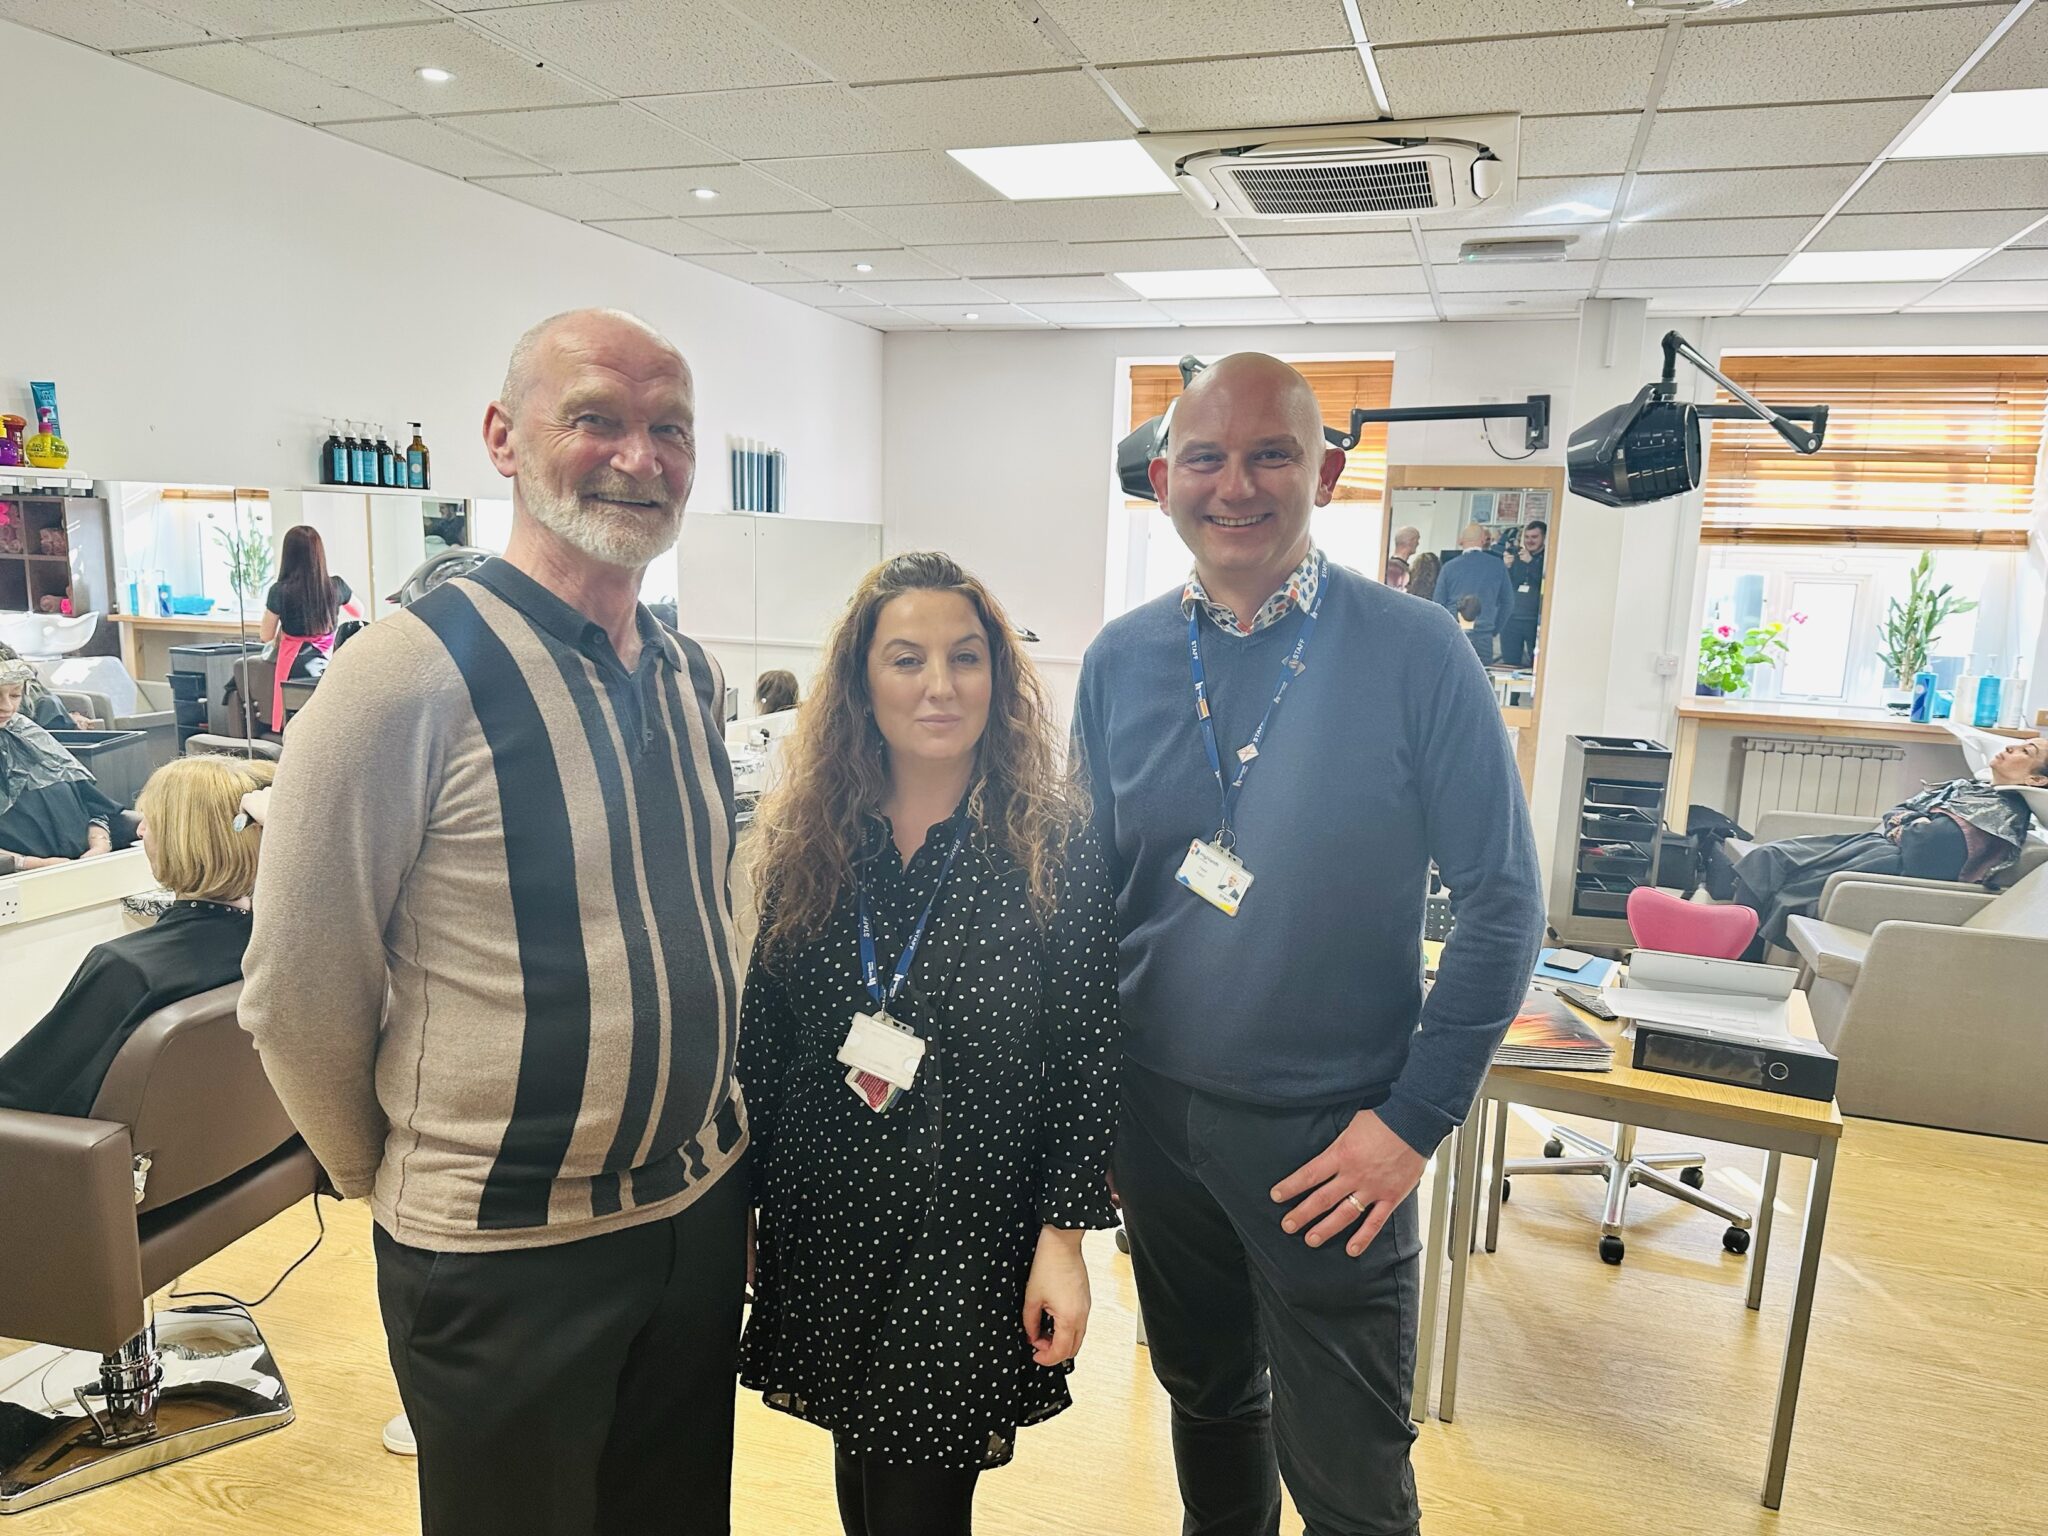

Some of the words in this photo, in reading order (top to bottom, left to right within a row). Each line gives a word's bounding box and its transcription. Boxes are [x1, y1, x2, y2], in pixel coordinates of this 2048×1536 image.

[1191, 640, 1199, 660] STAFF
[1292, 638, 1305, 660] STAFF
[862, 915, 871, 937] STAFF
